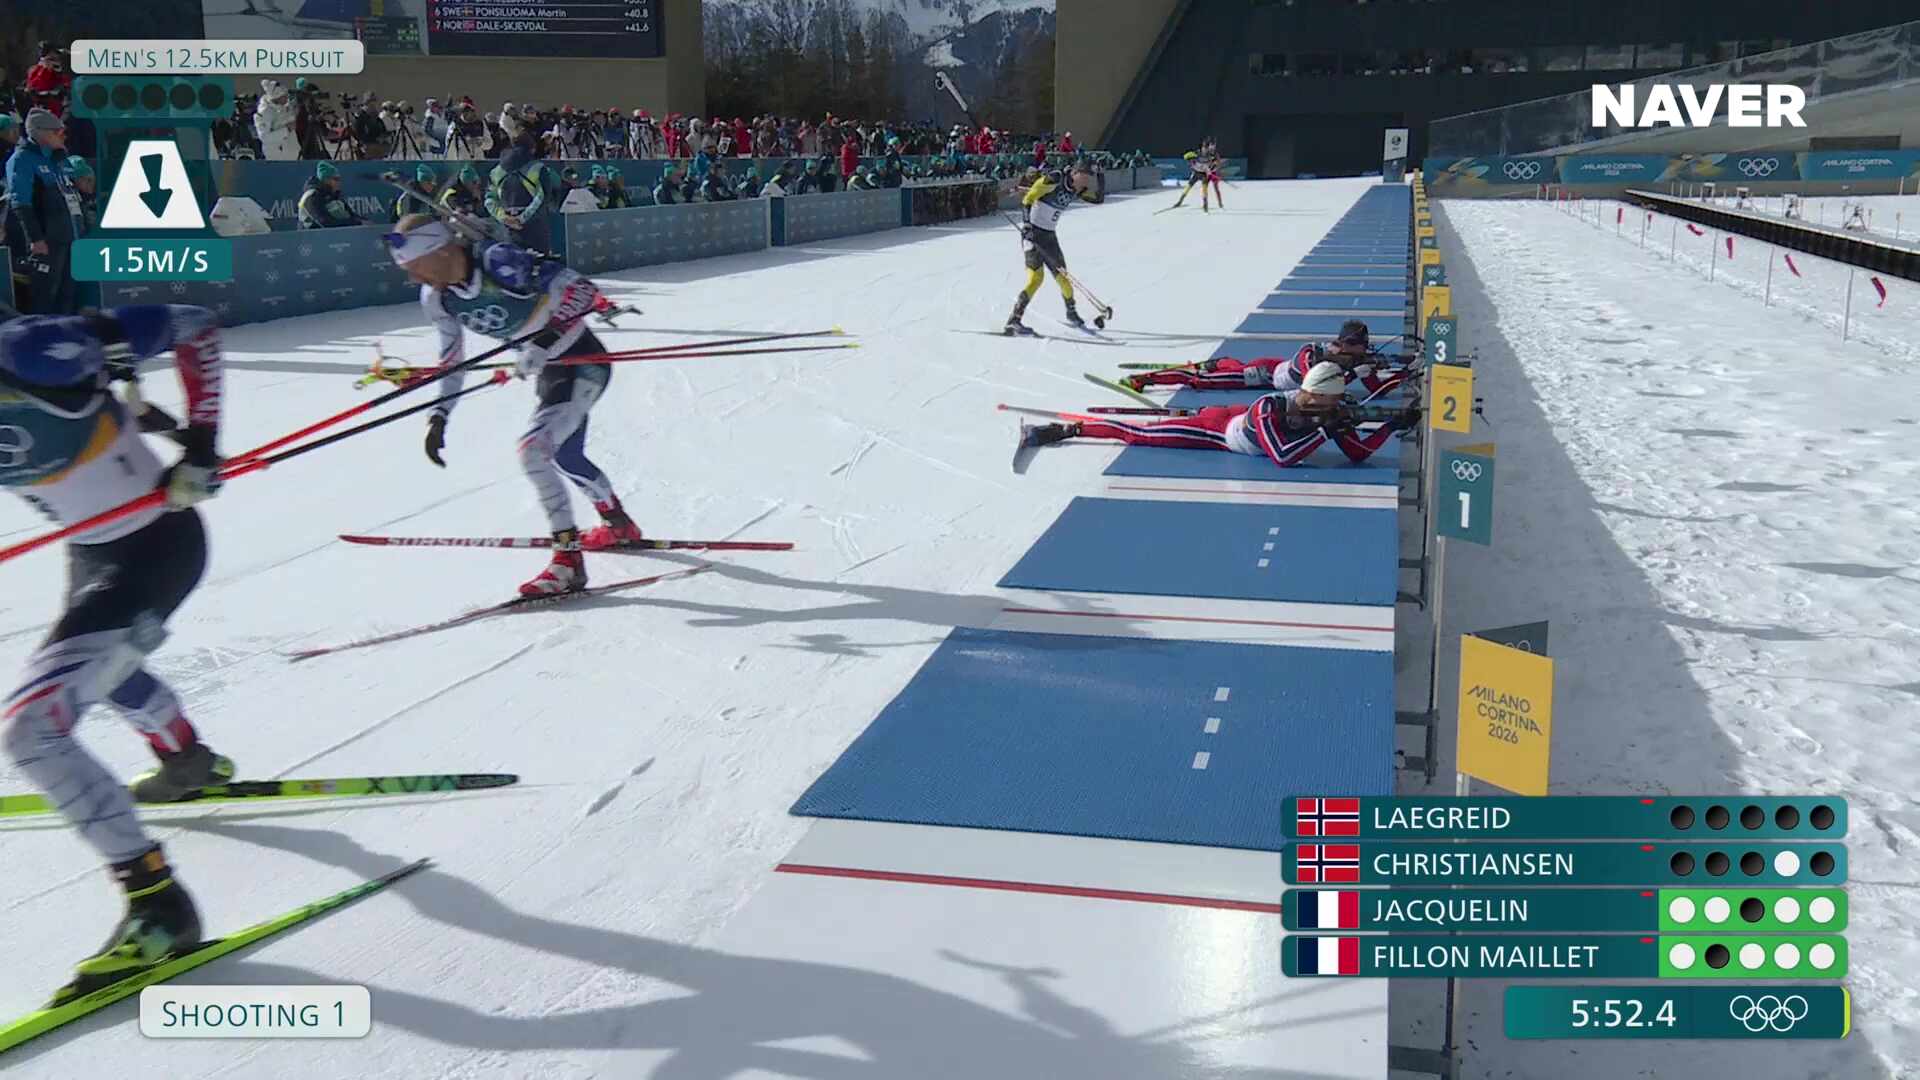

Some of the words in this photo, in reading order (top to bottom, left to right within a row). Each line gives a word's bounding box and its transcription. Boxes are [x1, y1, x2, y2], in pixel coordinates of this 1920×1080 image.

[442, 7, 461, 16] SWE
[475, 7, 536, 16] PONSILUOMA
[443, 20, 463, 29] NOR
[476, 21, 547, 30] DALE-SKJEVDAL
[1434, 340, 1446, 362] 3
[1443, 396, 1456, 422] 2
[1458, 491, 1470, 528] 1
[1467, 685, 1531, 714] MILANO
[1477, 703, 1543, 736] CORTINA
[1488, 723, 1519, 744] 2026
